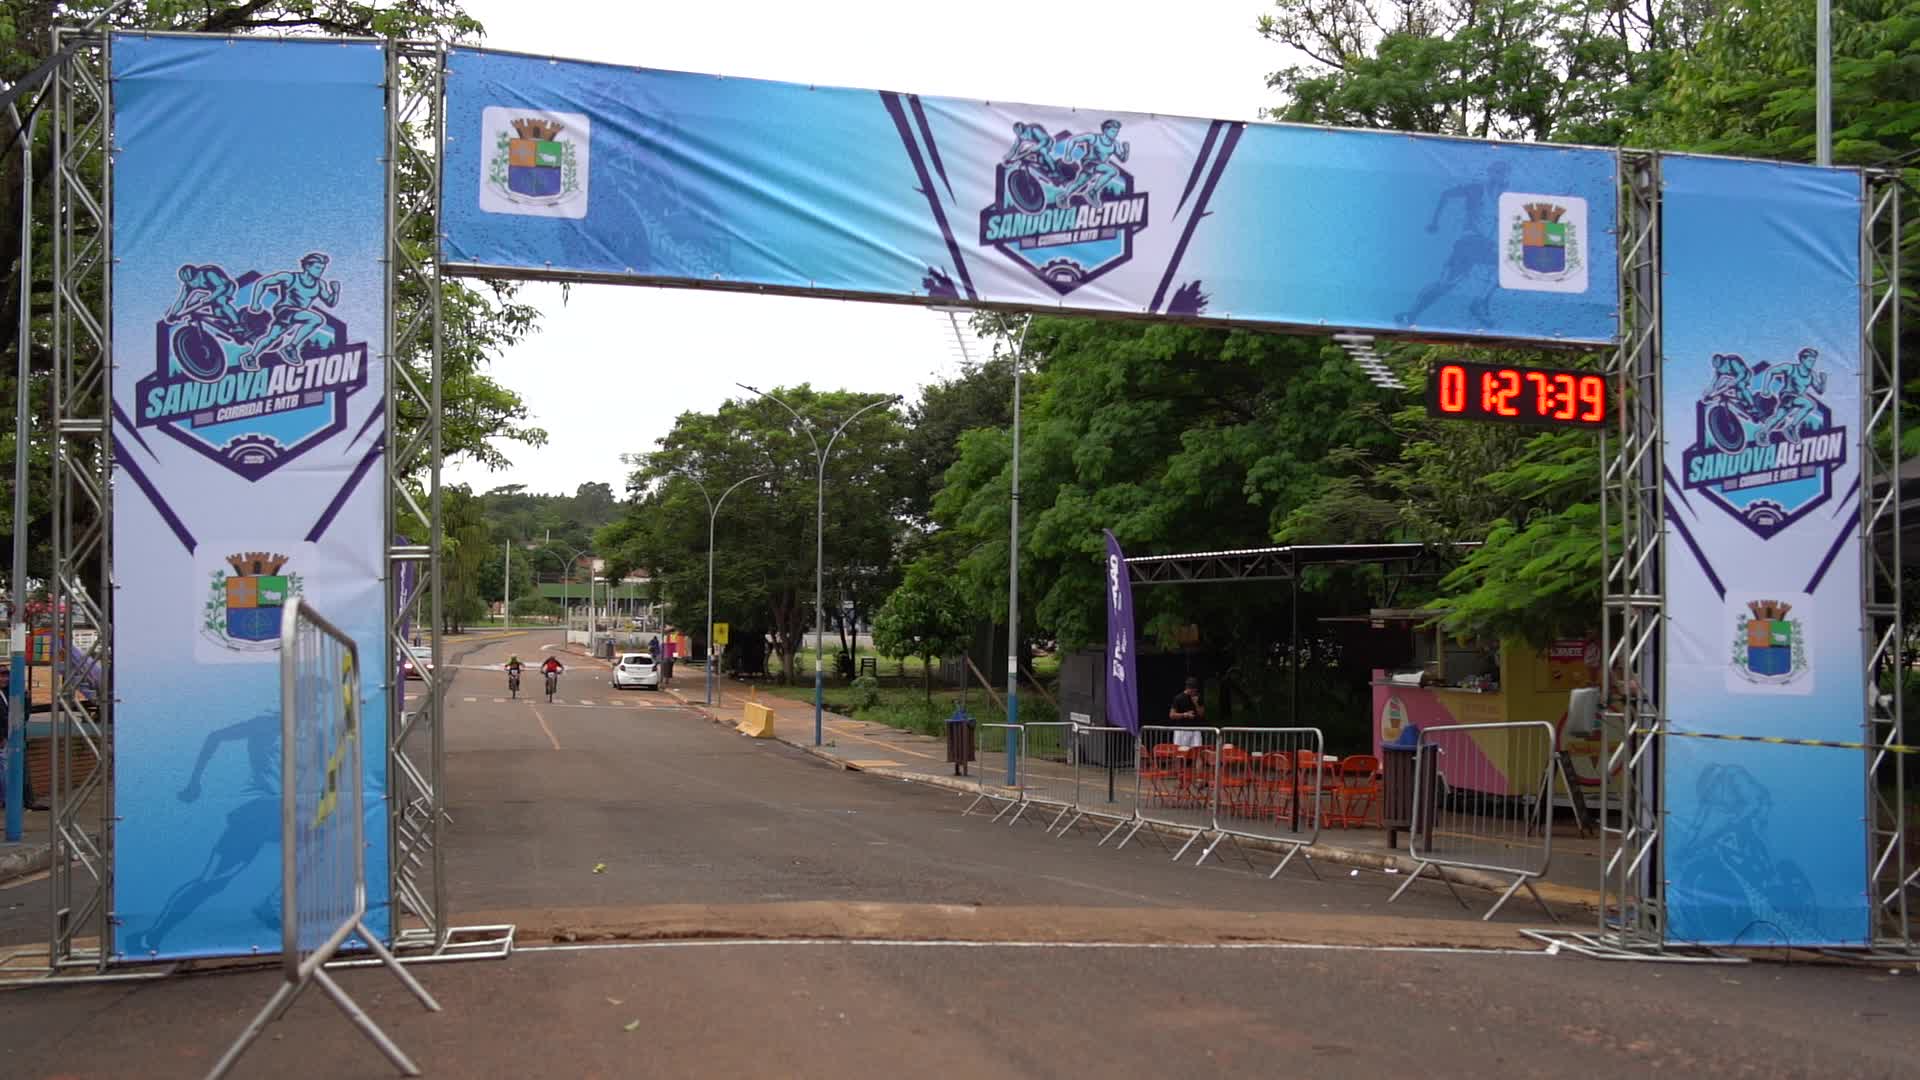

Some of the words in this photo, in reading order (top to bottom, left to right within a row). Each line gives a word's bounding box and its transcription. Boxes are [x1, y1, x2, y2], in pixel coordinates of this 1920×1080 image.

[986, 197, 1145, 241] SANDOVAACTION
[145, 350, 362, 419] SANDOVAACTION
[216, 400, 263, 422] CORRIDA
[265, 399, 273, 413] E
[274, 394, 299, 412] MTB
[1688, 431, 1844, 484] SANDOVAACTION
